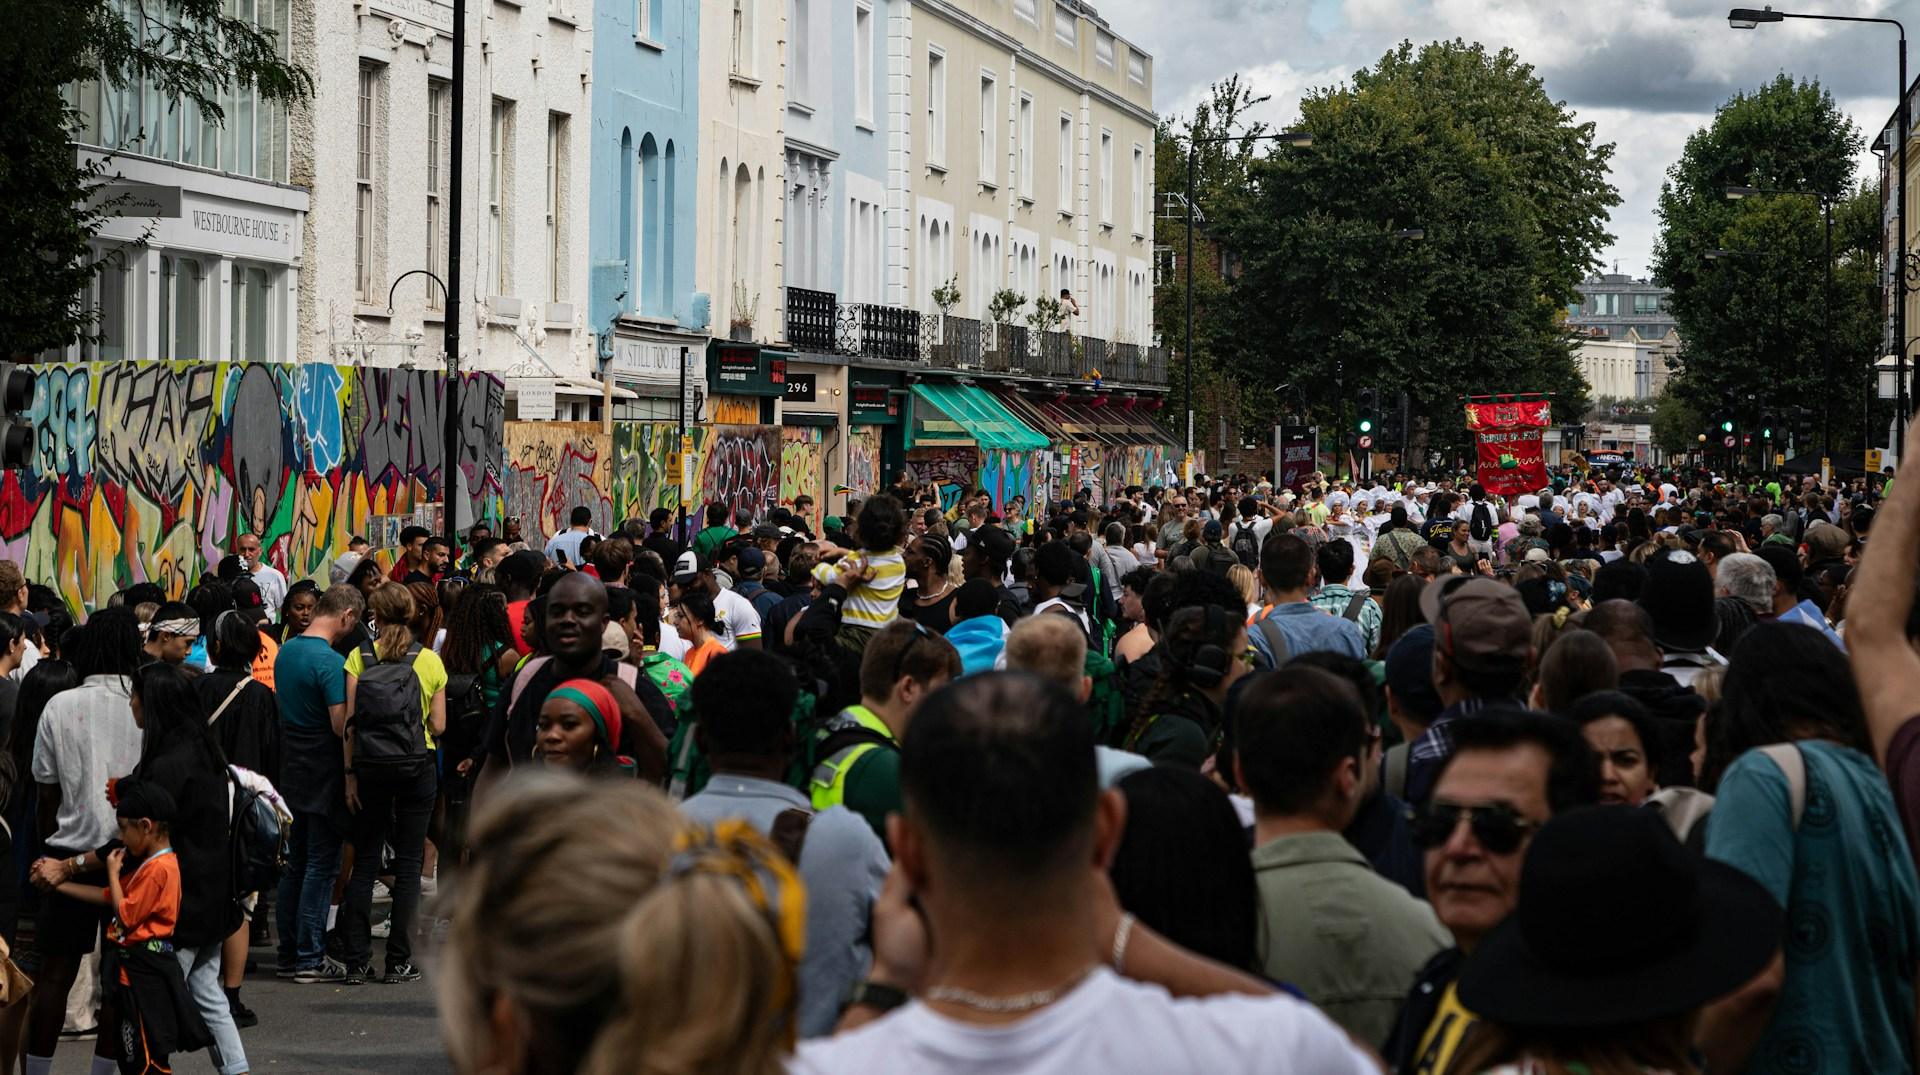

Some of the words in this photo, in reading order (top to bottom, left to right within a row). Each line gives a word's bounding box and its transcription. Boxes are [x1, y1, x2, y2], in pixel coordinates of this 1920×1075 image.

[193, 210, 250, 237] WESTBOURNE
[252, 219, 279, 241] HOUSE
[627, 344, 651, 367] STILL
[652, 346, 670, 369] TOO
[787, 382, 809, 393] 296
